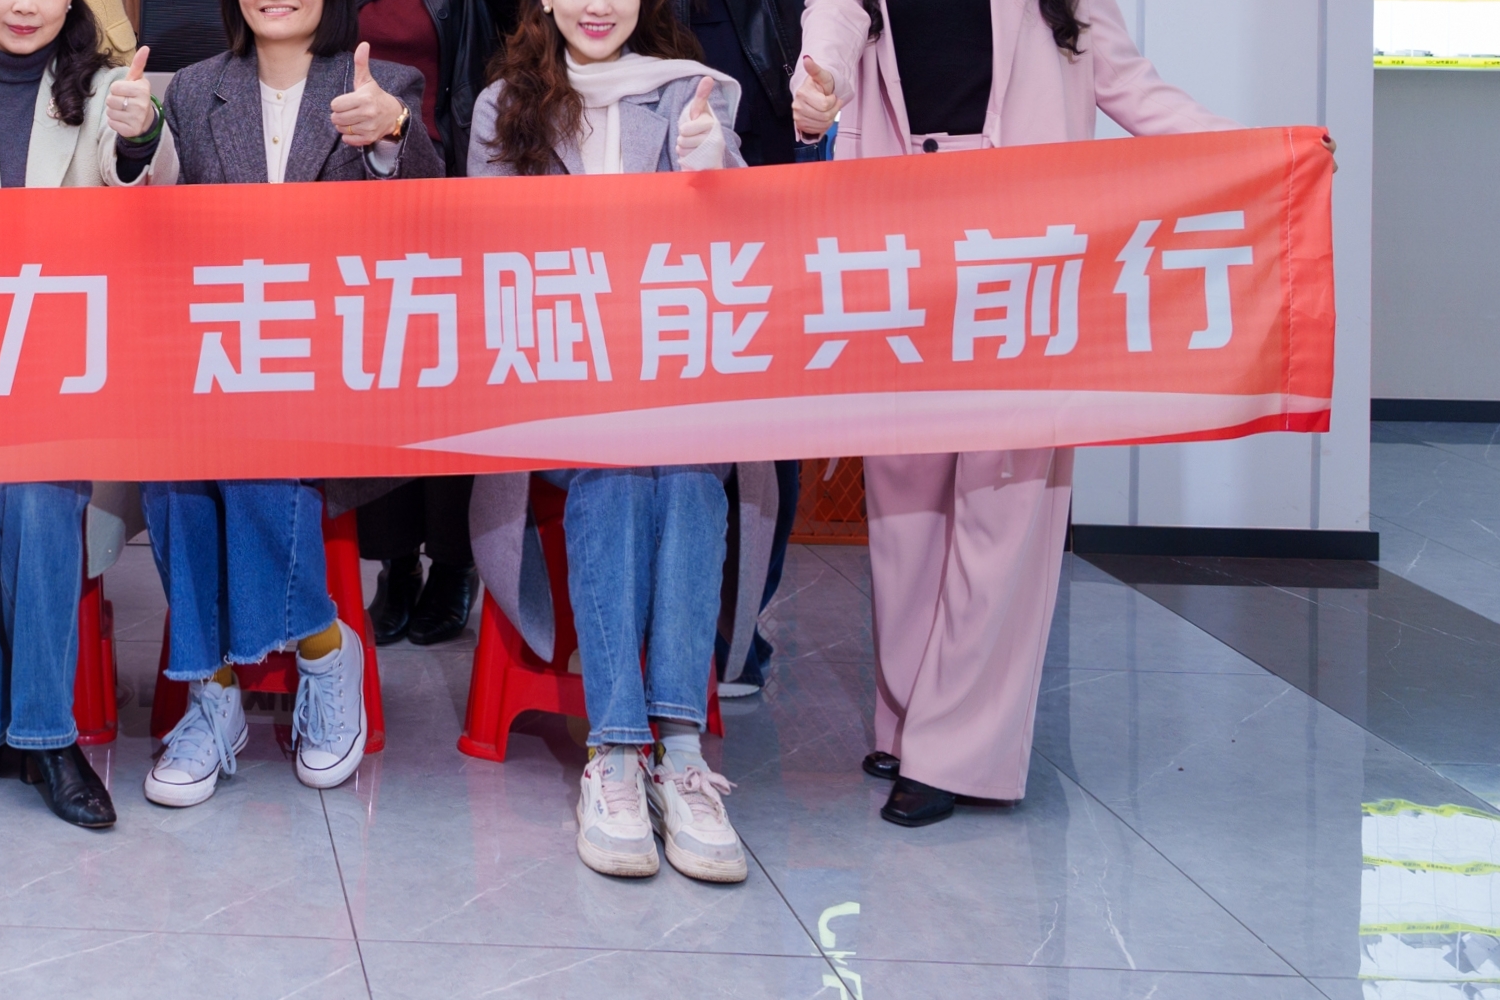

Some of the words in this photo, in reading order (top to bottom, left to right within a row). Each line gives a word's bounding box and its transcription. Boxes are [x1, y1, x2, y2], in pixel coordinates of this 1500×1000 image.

[189, 210, 1255, 395] 走访赋能共前行
